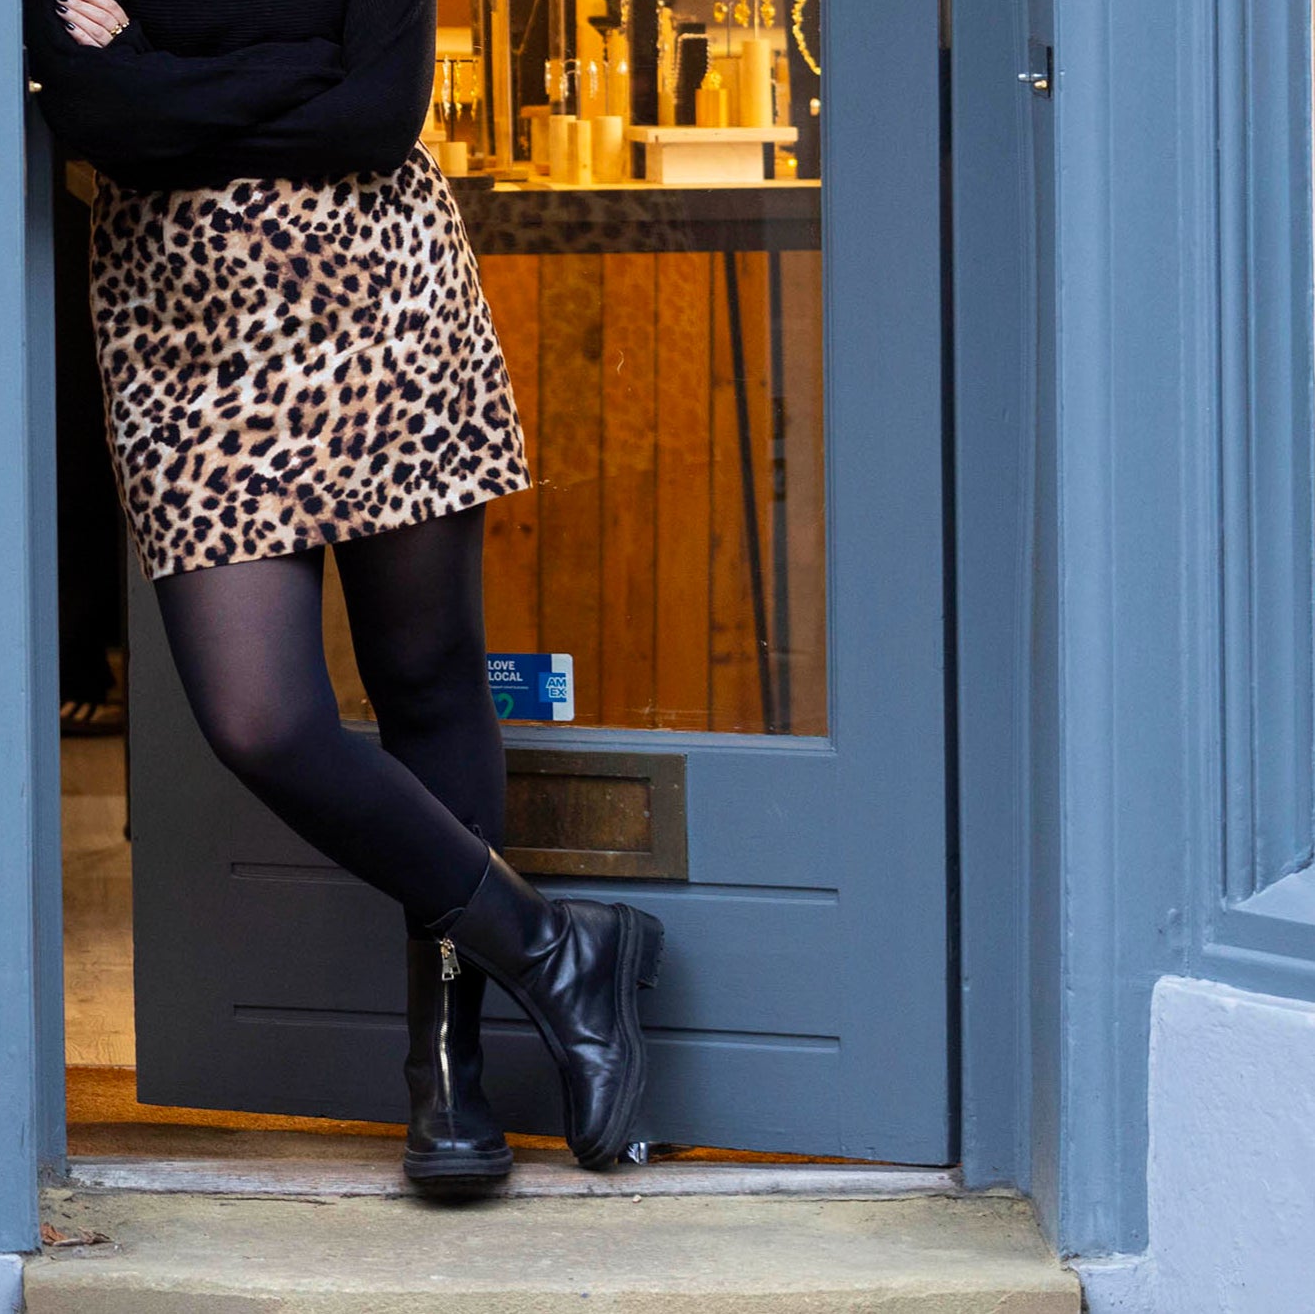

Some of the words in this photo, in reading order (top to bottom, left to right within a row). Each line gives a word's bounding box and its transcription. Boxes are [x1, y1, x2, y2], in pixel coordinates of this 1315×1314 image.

[488, 660, 516, 670] LOVE
[488, 672, 523, 681] LOCAL
[547, 677, 566, 687] AM
